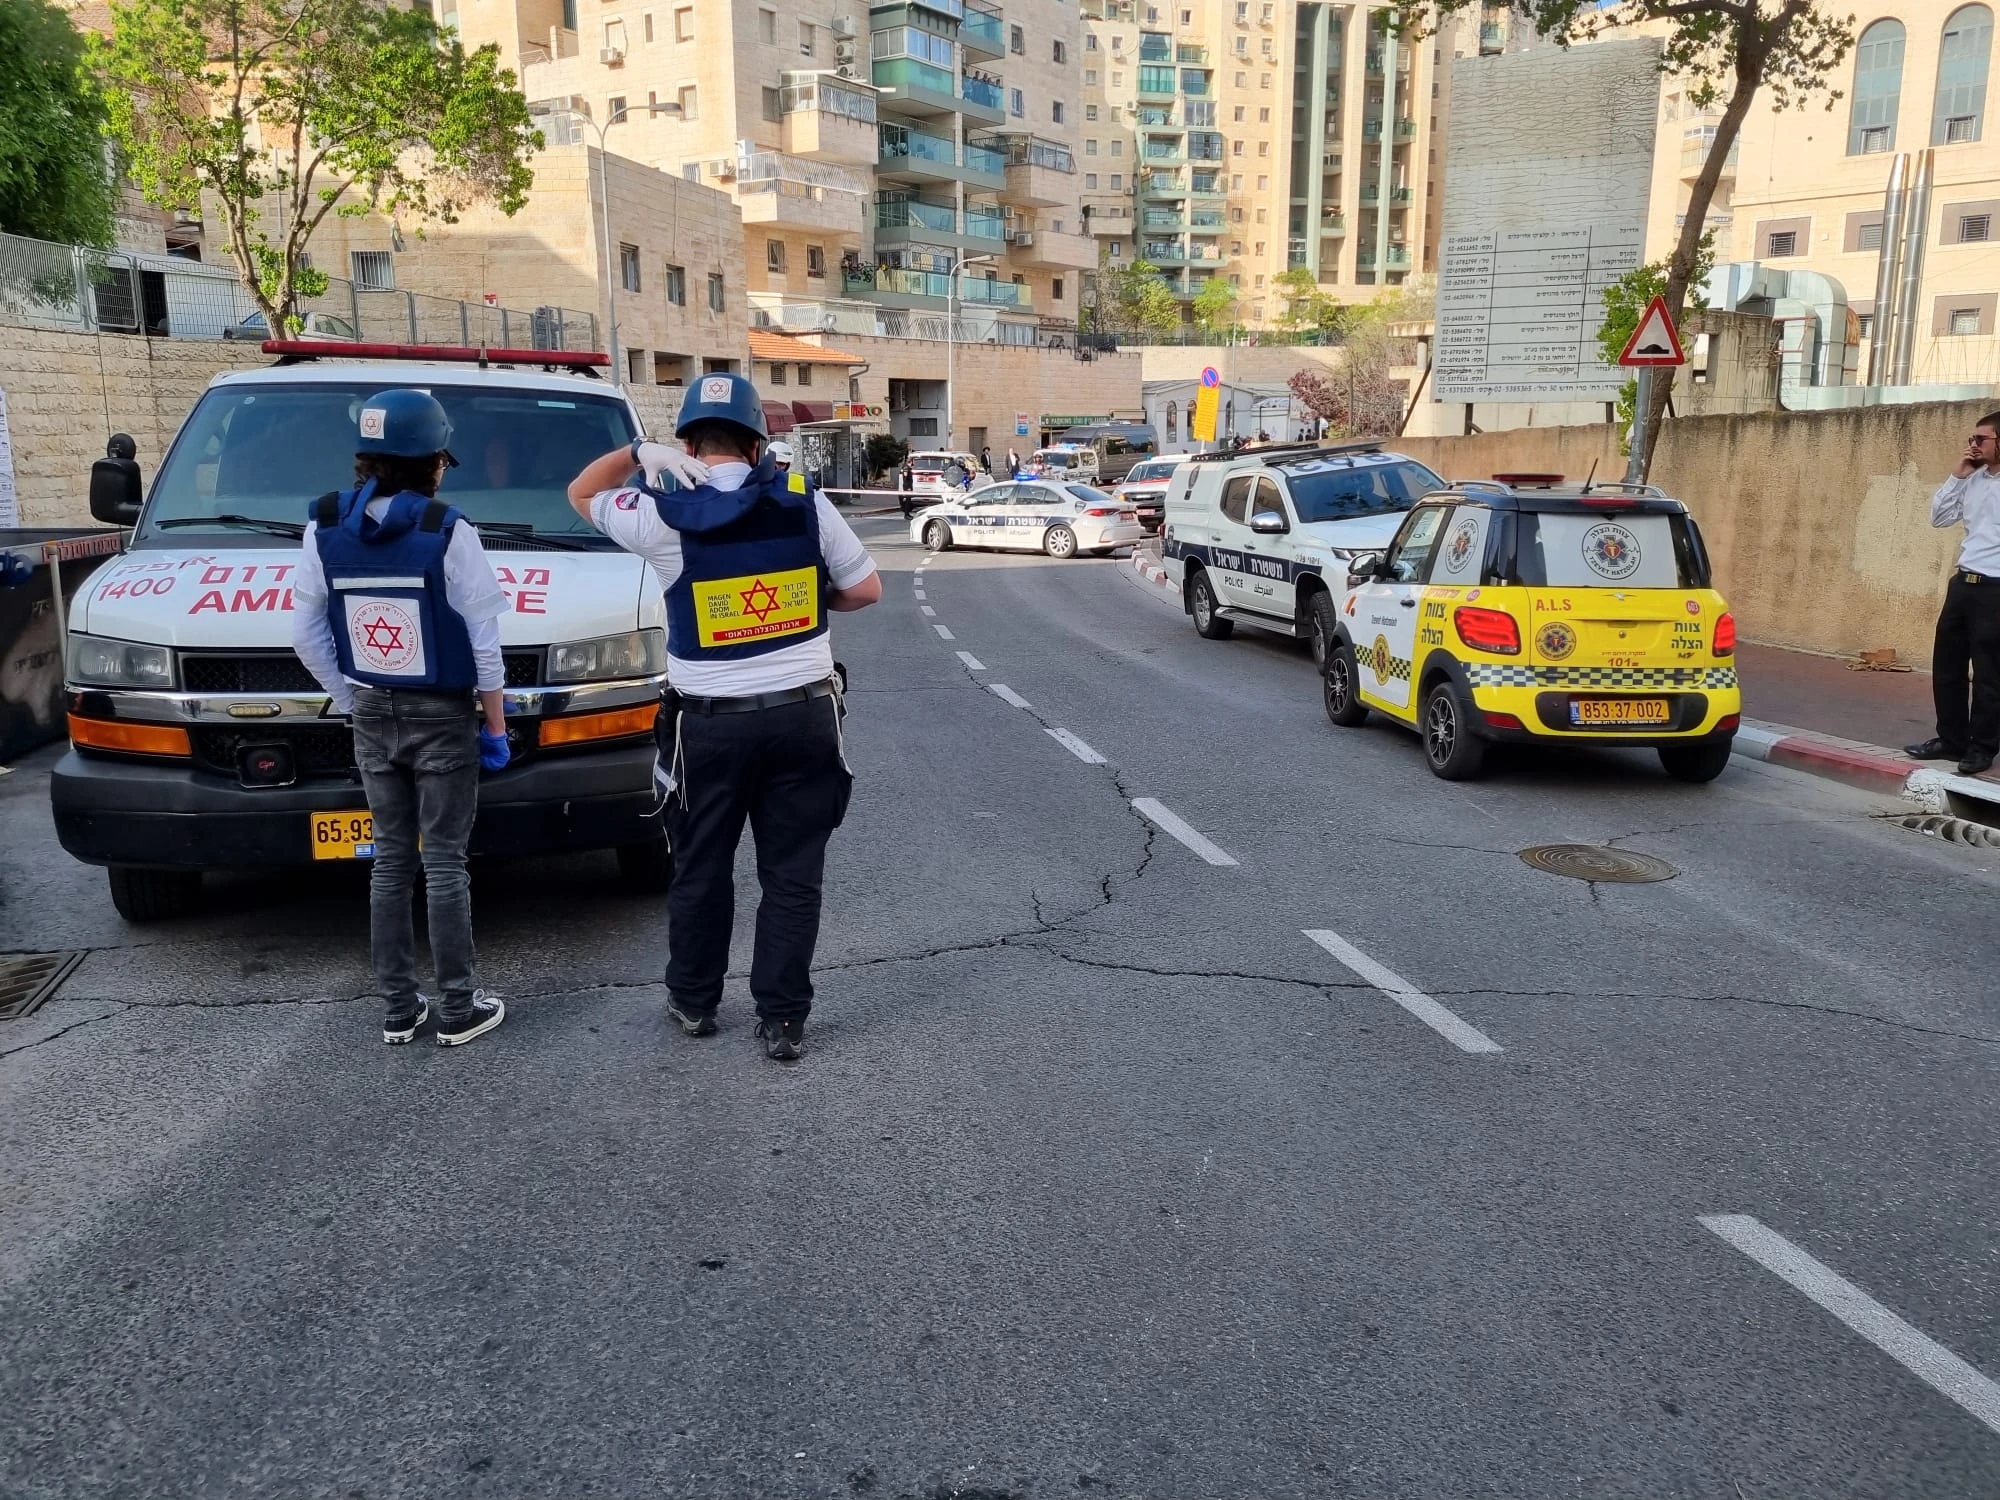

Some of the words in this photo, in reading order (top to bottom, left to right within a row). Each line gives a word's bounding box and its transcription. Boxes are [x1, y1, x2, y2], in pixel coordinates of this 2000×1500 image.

[966, 516, 996, 525] ישראל
[1007, 516, 1045, 526] משטרת
[1590, 527, 1610, 539] הצלה
[1613, 527, 1630, 539] צוות
[1215, 549, 1241, 570] ישראל
[1250, 558, 1283, 579] משטרת
[1588, 556, 1610, 575] TZEVET
[1611, 556, 1637, 576] HATZOLAH
[783, 583, 796, 592] דוד
[1224, 575, 1244, 589] POLICE
[98, 576, 177, 602] 1400
[791, 590, 808, 599] אדום
[707, 593, 732, 602] MAGEN
[782, 598, 809, 609] בישראל
[708, 600, 729, 608] DAVID
[1535, 598, 1572, 612] A.L.S
[718, 611, 740, 619] ISRAEL
[1424, 602, 1447, 619] צוות
[754, 623, 780, 634] ההצלה
[781, 620, 800, 631] ארגון
[1673, 622, 1701, 633] צוות
[724, 629, 753, 639] הלאומי
[1421, 623, 1444, 646] הצלה
[355, 631, 367, 653] MAGEN
[367, 653, 383, 666] DAVID
[1671, 637, 1703, 650] הצלה
[1584, 702, 1663, 718] 853-37-002
